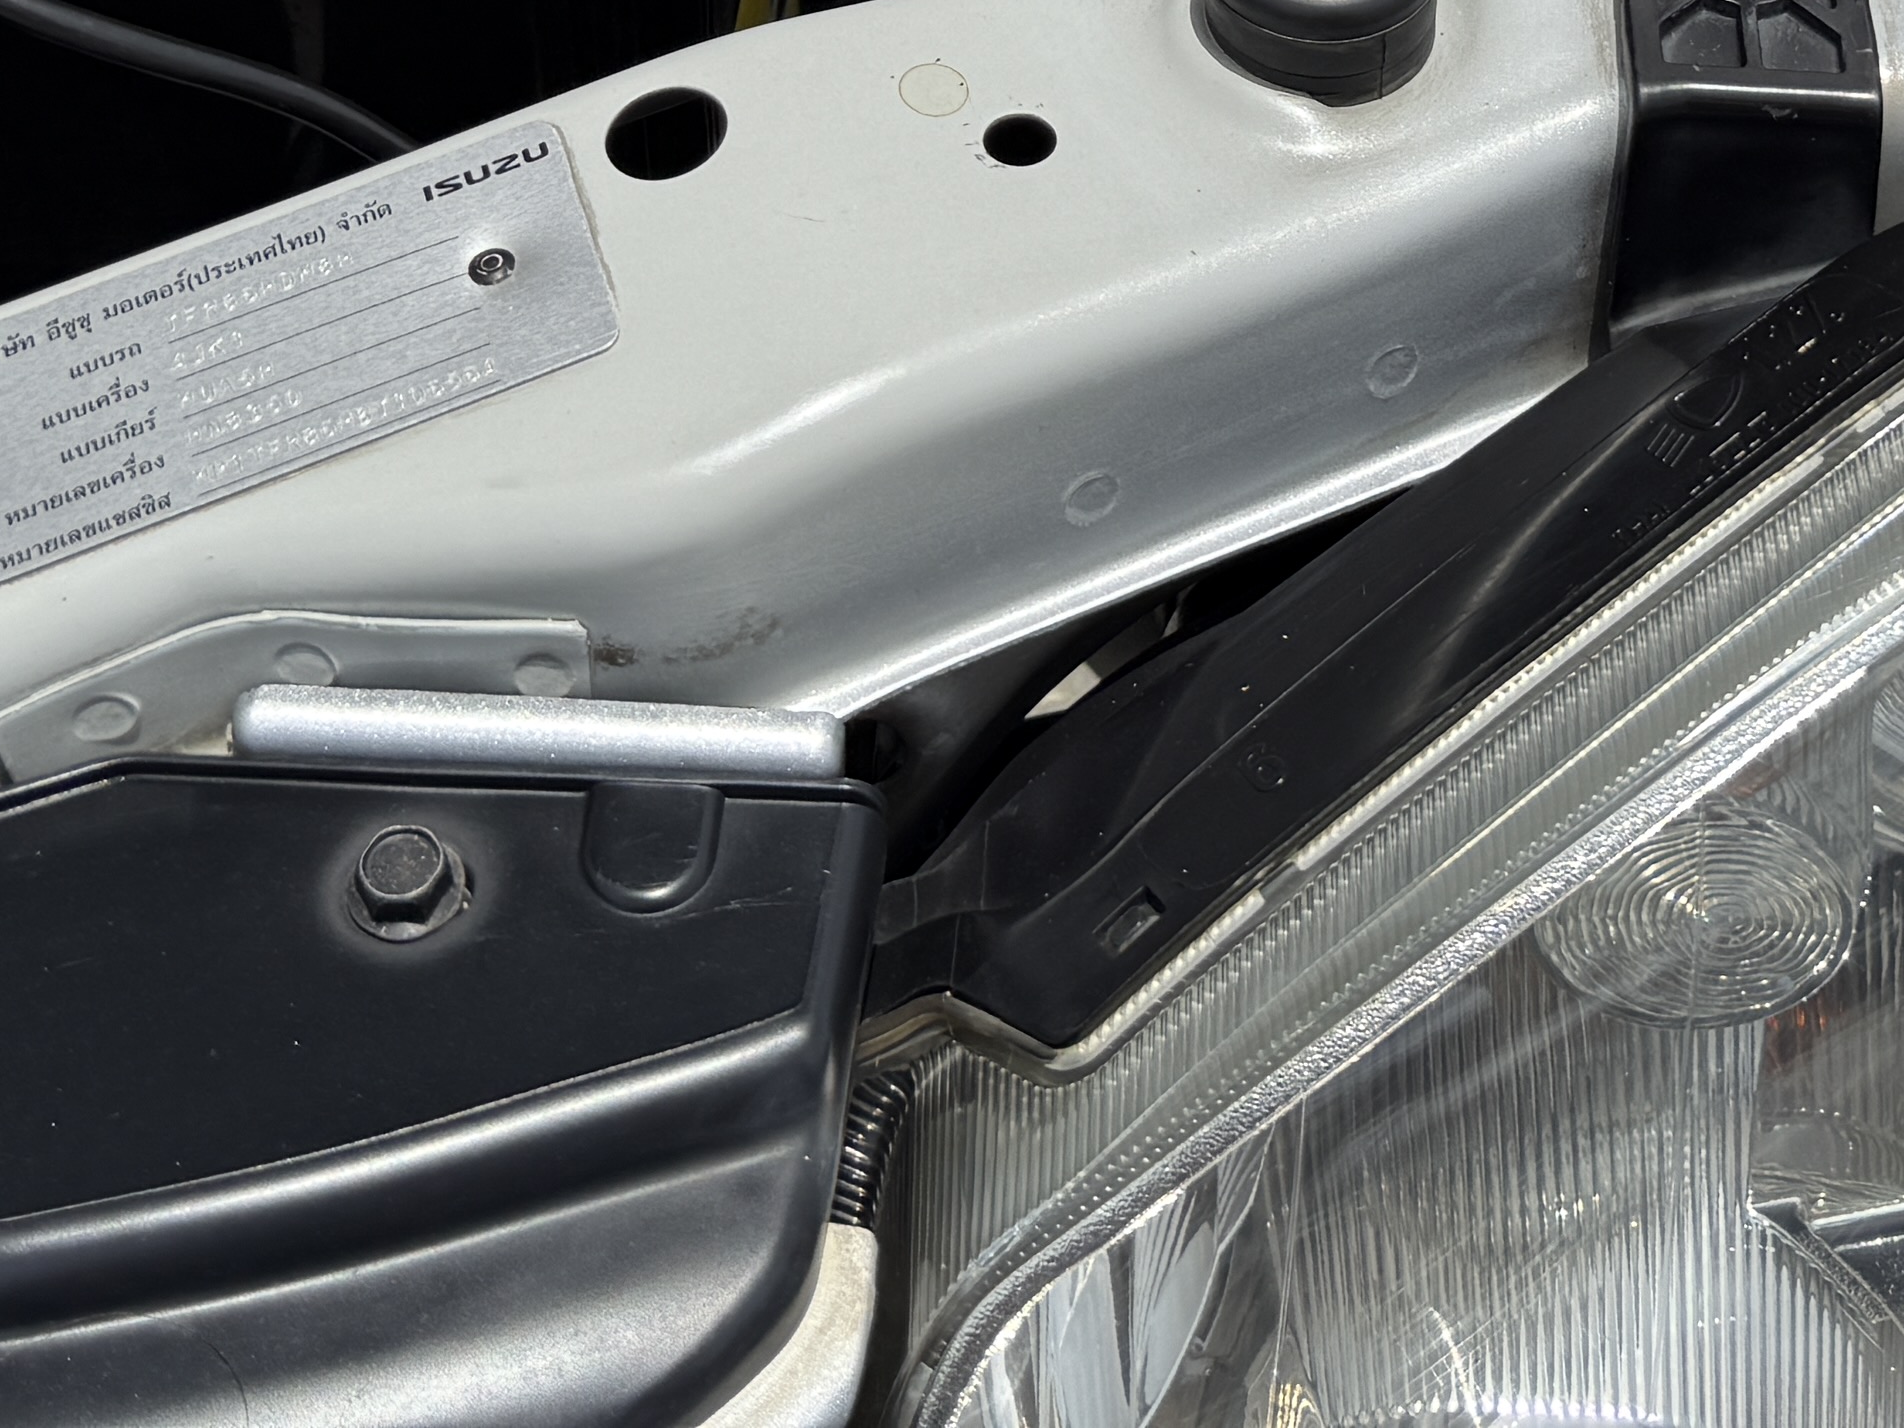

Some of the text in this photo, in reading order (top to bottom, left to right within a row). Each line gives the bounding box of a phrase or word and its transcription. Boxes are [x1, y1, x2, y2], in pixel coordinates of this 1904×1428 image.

[46, 313, 92, 341] อีซูซุ
[103, 226, 325, 320] มอเตอร์(ประเทศไทย)
[336, 200, 392, 230] จำกัด
[423, 142, 548, 201] ISUZU
[70, 343, 141, 379] แบบรถ
[42, 377, 149, 430] แบบเครื่อง
[61, 407, 157, 463] แบบเกียร์
[5, 452, 164, 525] หมายเลขเครื่อง
[0, 492, 171, 569] หมายเลขแชสซิส
